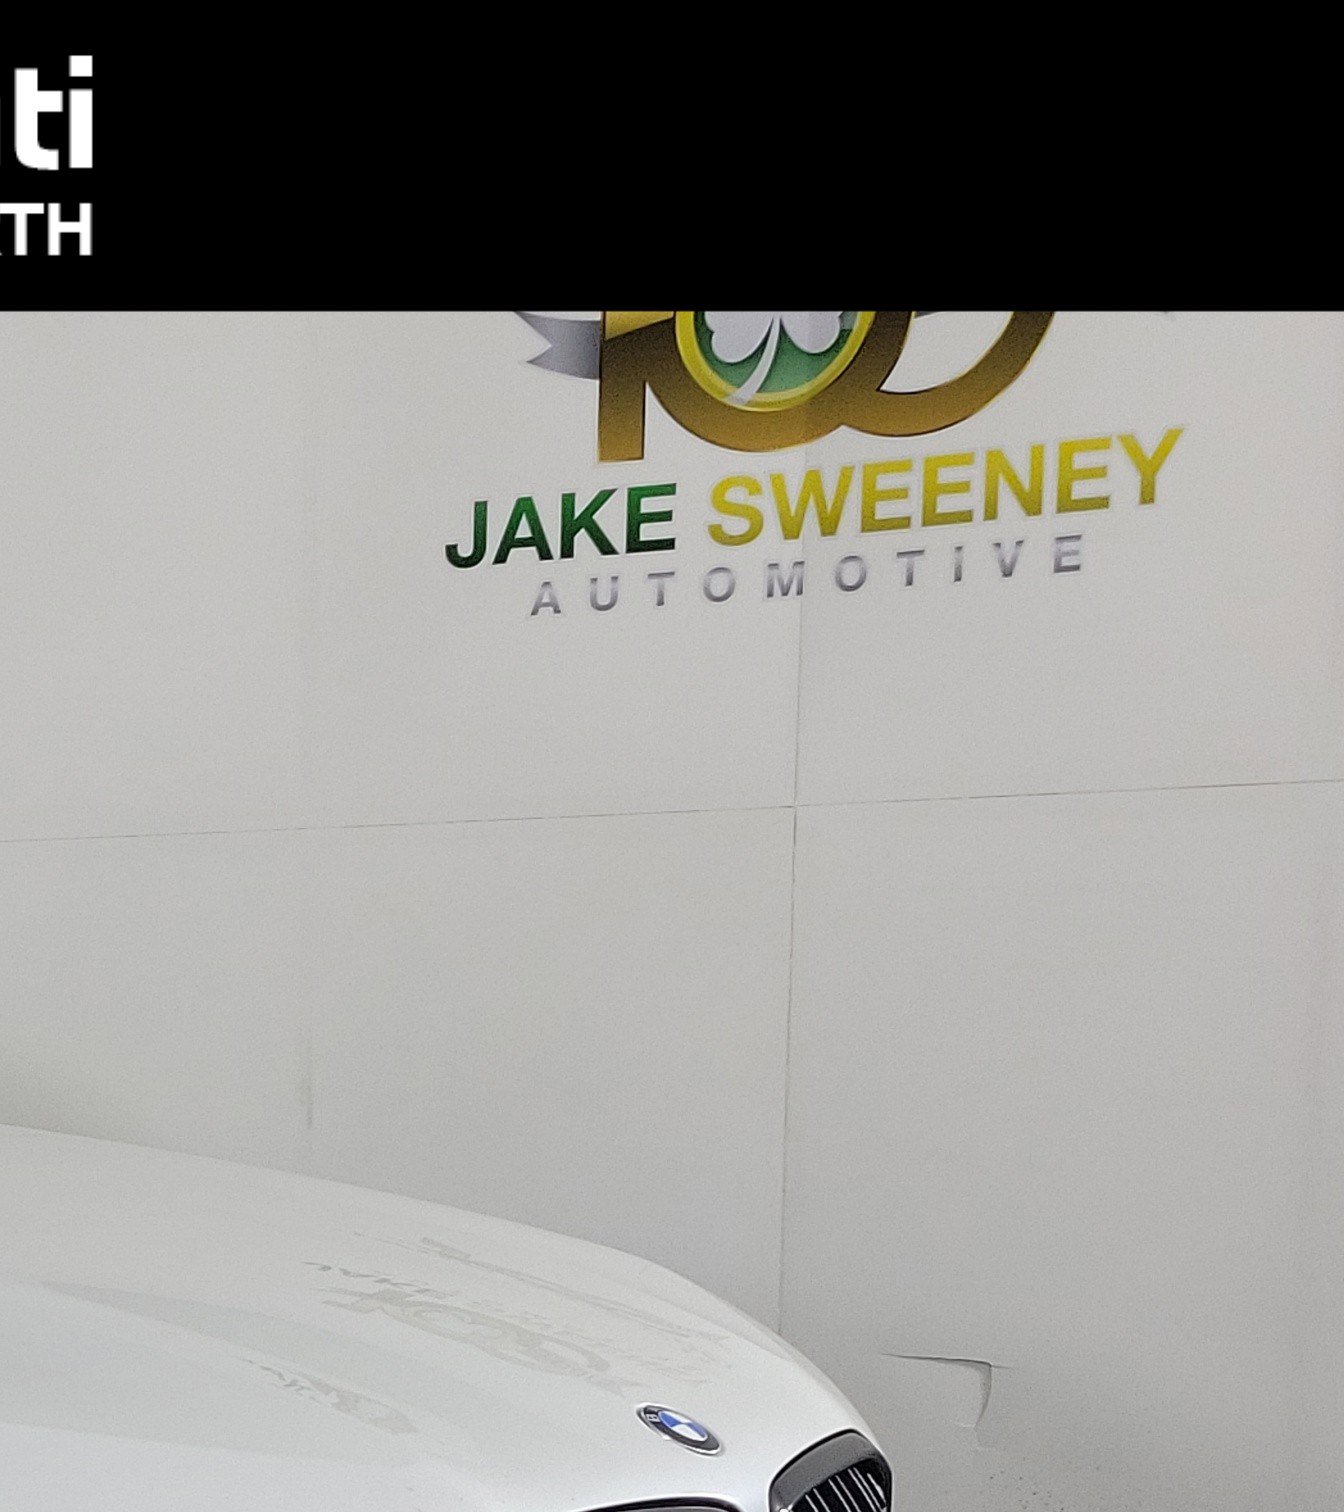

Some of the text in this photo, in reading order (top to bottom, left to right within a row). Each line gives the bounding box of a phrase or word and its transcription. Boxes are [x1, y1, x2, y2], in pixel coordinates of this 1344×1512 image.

[445, 427, 1185, 569] JAKE SWEENEY
[530, 533, 1084, 616] AUTOMOTIVE
